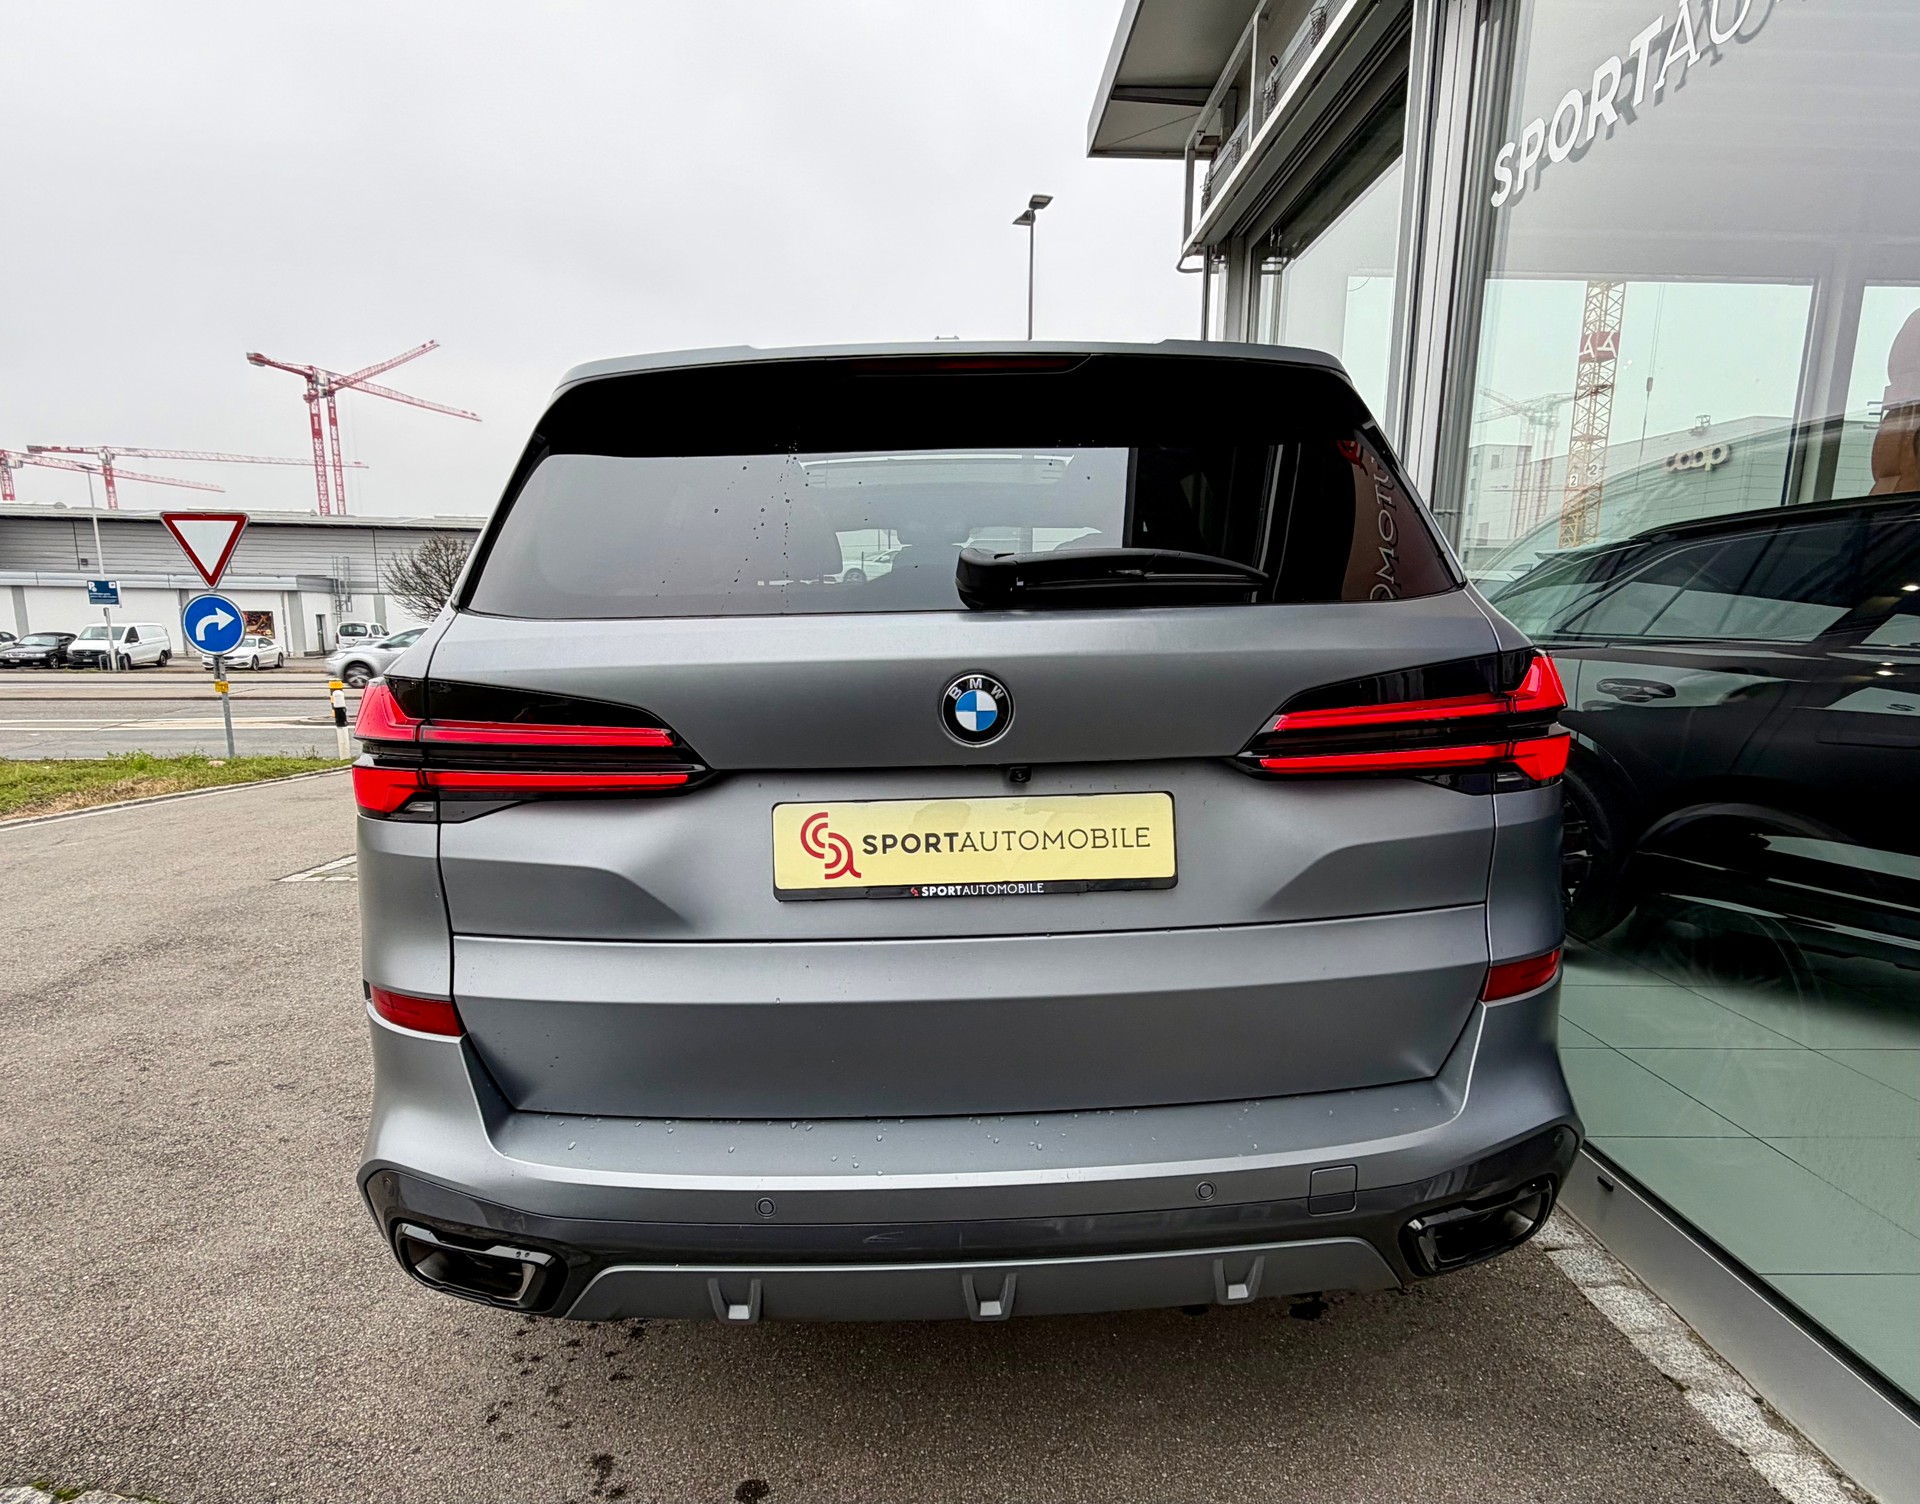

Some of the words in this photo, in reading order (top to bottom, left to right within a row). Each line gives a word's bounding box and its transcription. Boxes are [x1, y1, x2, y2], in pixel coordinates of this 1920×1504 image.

[1490, 0, 1781, 208] SPORTAU
[948, 678, 1005, 701] BMW
[862, 827, 1152, 856] SPORTAUTOMOBILE
[921, 882, 1045, 898] SPORTAUTOMOBILE
